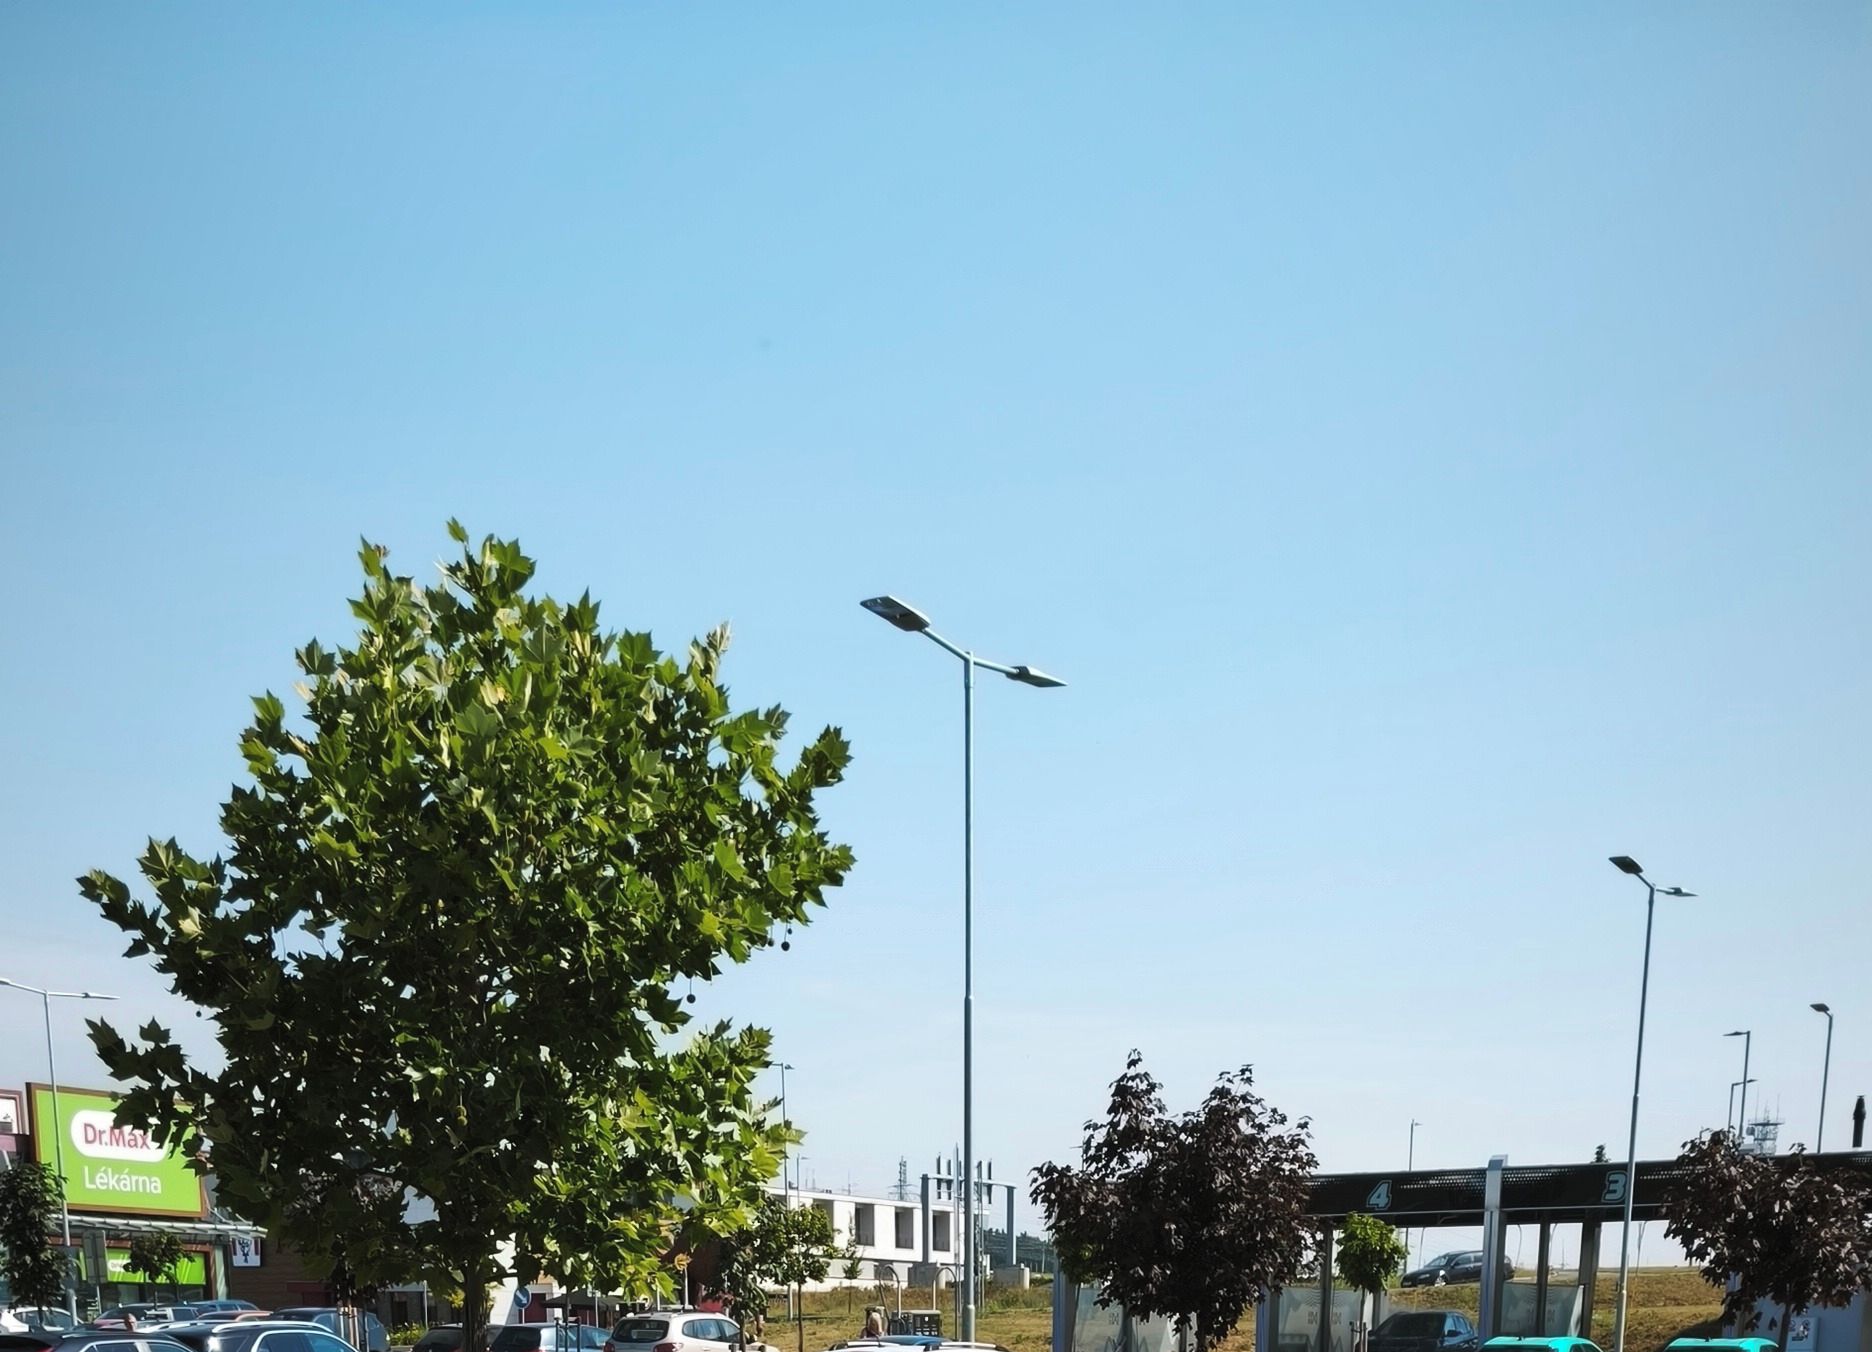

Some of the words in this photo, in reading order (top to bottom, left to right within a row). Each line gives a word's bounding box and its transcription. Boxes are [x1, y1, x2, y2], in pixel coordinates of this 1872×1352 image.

[83, 1122, 150, 1150] Dr.Max
[84, 1166, 162, 1194] Lékárna
[1602, 1171, 1628, 1203] 3
[1367, 1180, 1392, 1210] 4
